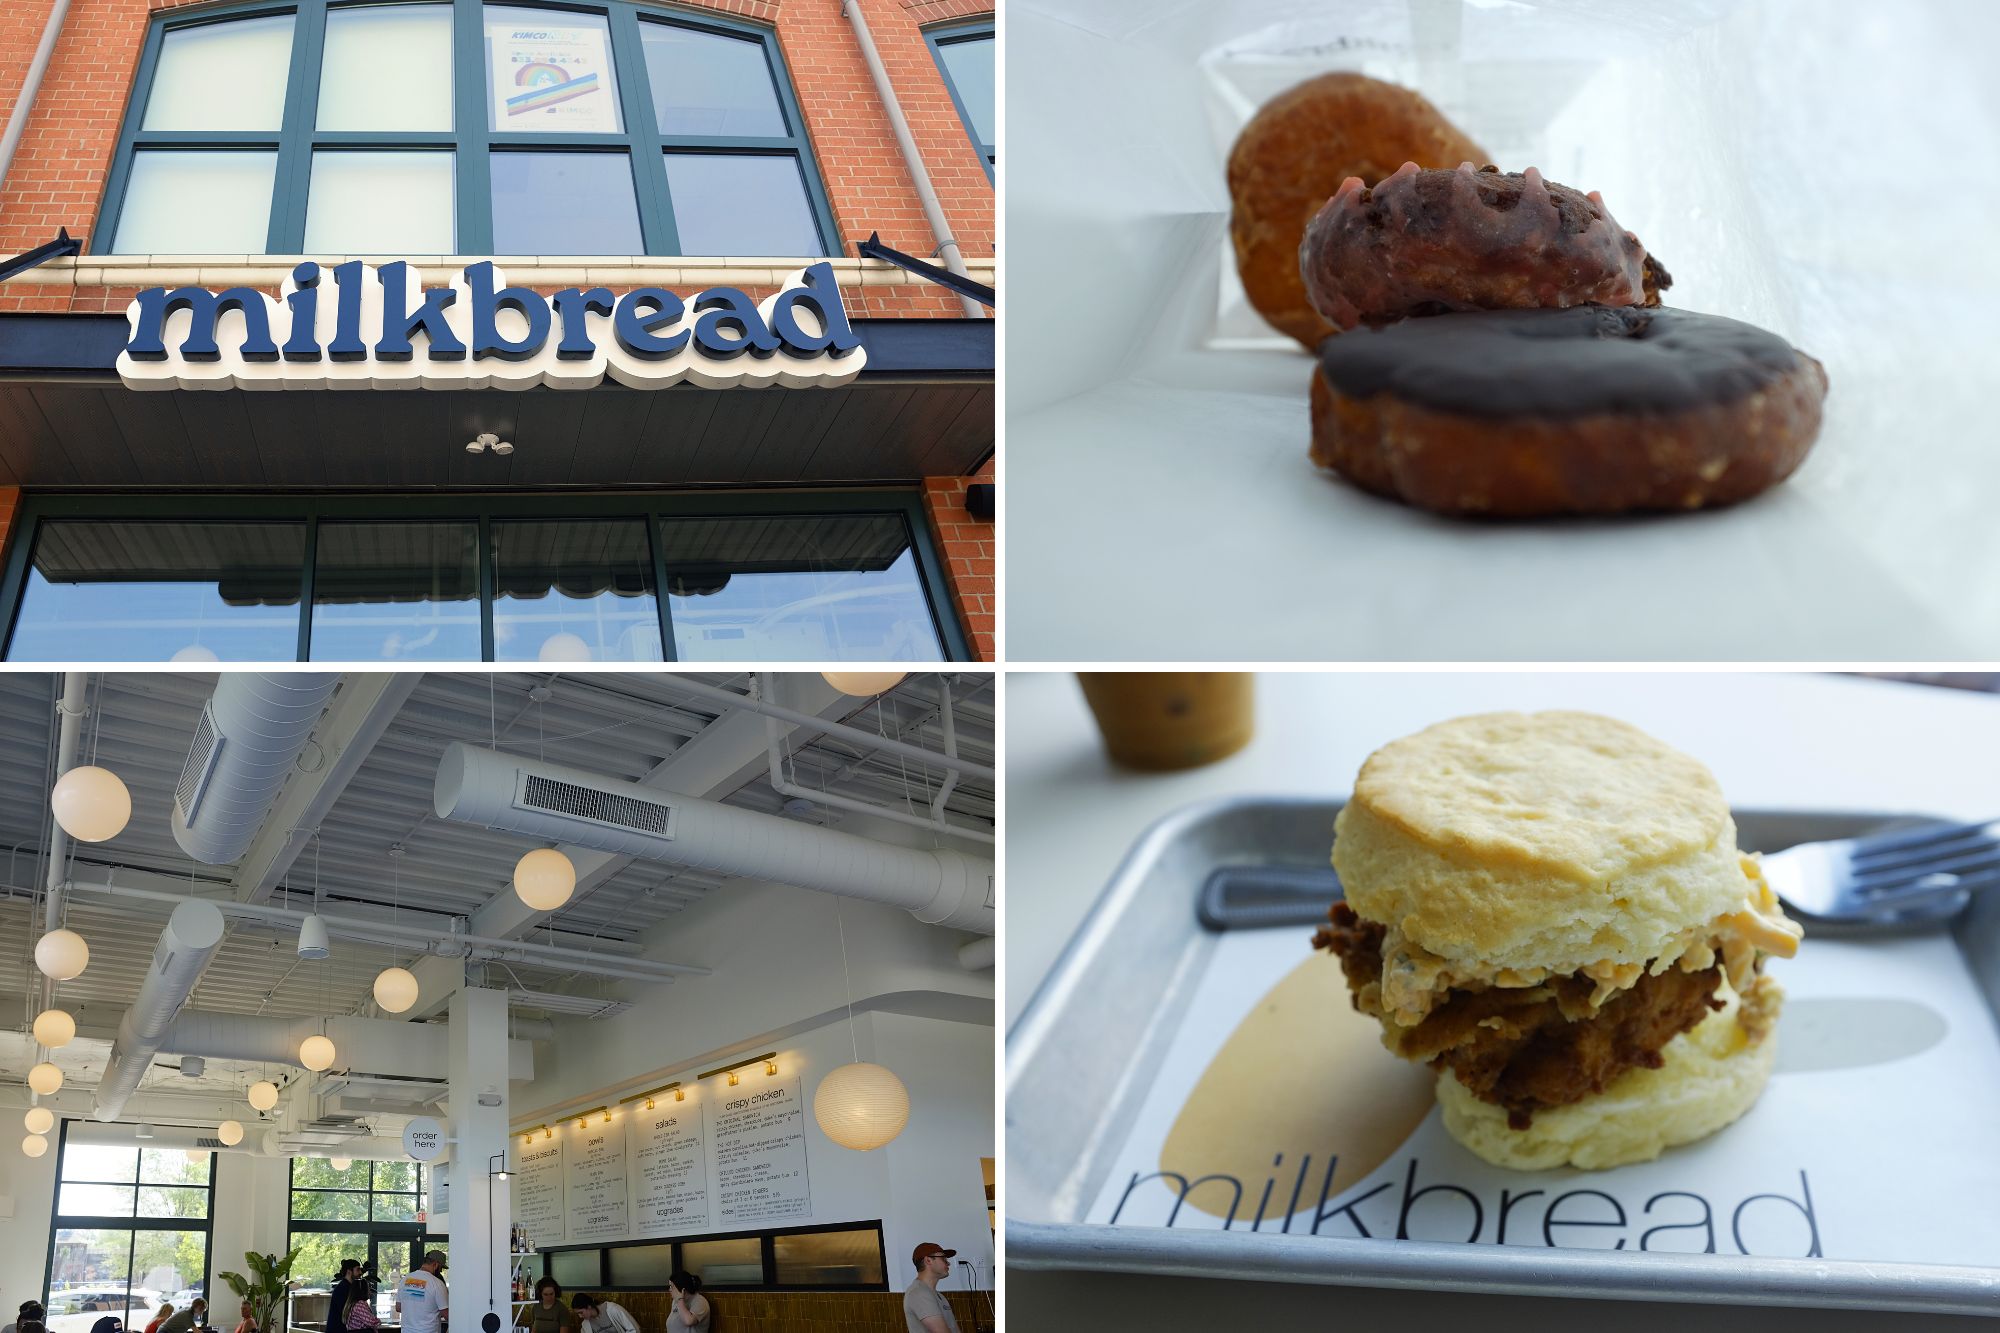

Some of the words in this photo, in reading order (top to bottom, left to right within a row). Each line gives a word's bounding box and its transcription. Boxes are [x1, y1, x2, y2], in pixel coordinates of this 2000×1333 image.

[511, 31, 547, 39] KIMCO
[126, 259, 862, 364] milkbread
[725, 1096, 750, 1112] crispy
[751, 1087, 785, 1105] chicken
[655, 1116, 677, 1130] salads
[412, 1131, 438, 1140] order
[414, 1139, 436, 1149] here
[1109, 1152, 1825, 1258] milkbread
[656, 1206, 683, 1219] upgrades
[587, 1215, 609, 1227] upgrades
